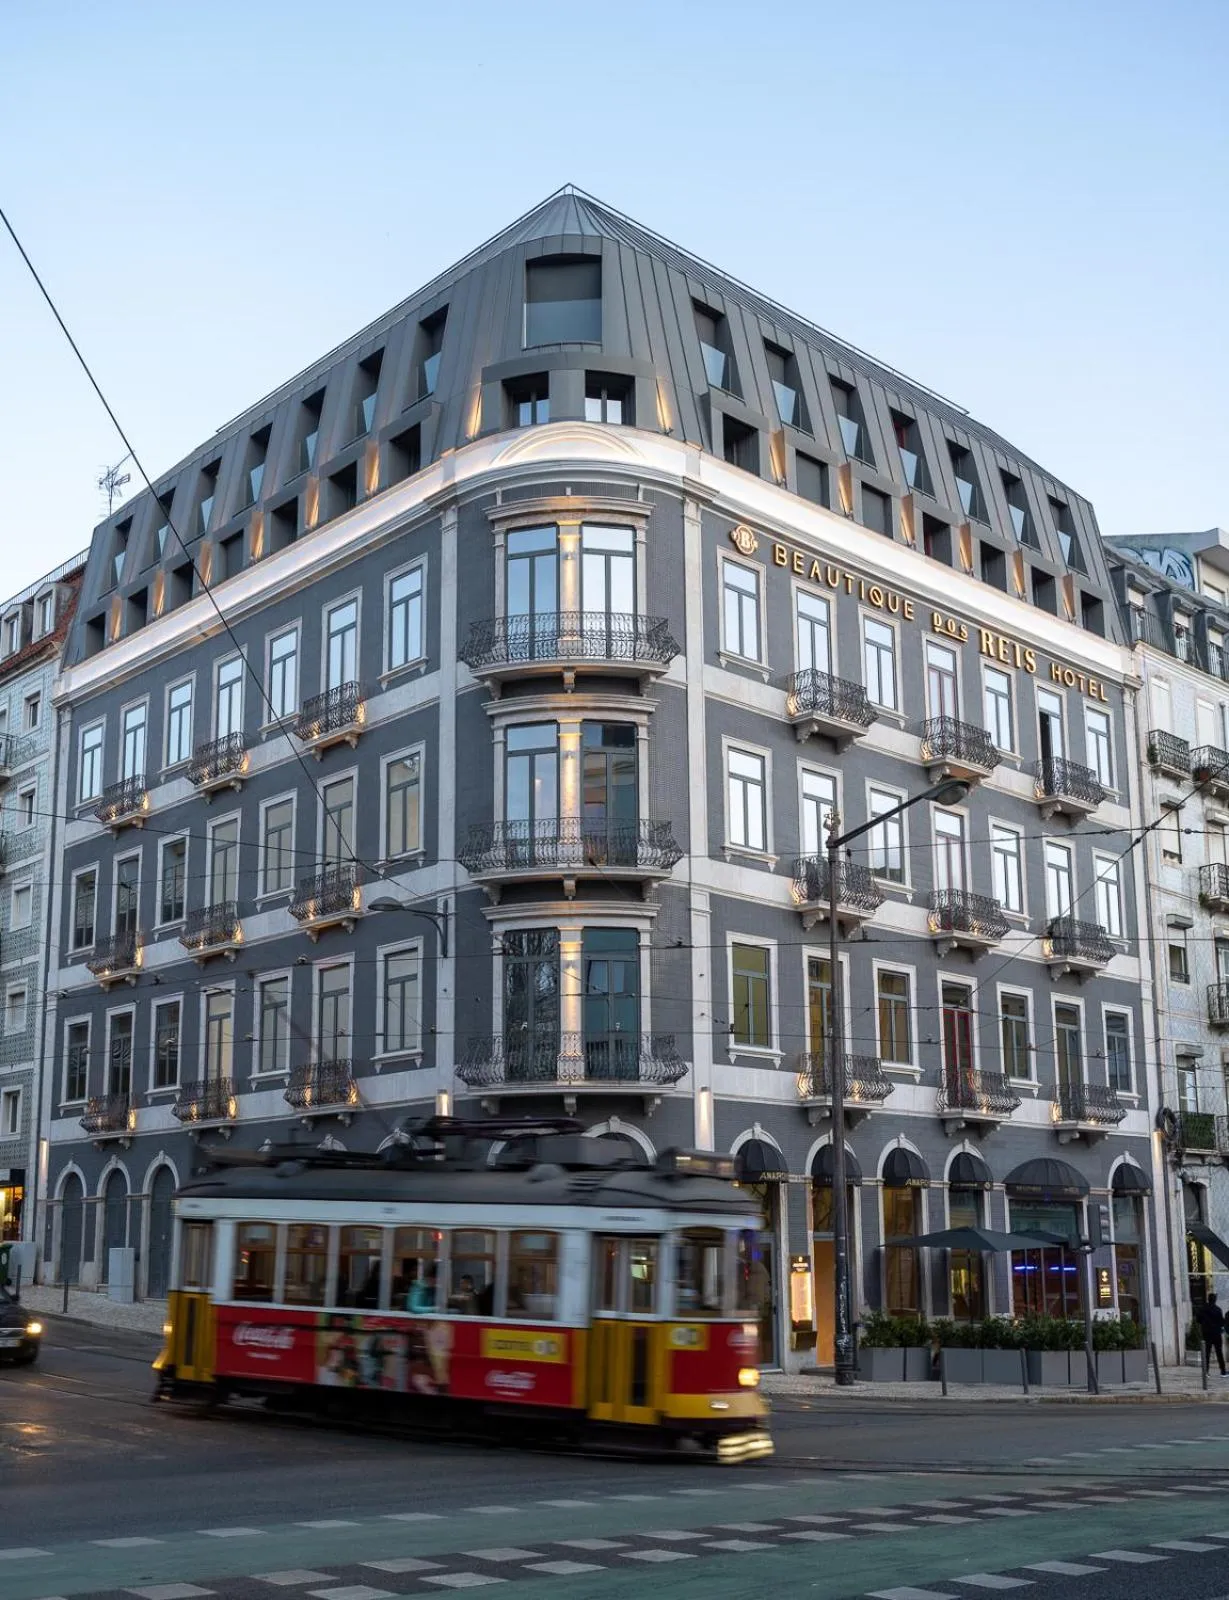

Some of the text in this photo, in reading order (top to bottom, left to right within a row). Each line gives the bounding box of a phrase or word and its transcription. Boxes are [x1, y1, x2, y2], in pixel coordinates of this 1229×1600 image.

[773, 543, 1109, 702] BEAUTIQUE DOS REIS HOTEL
